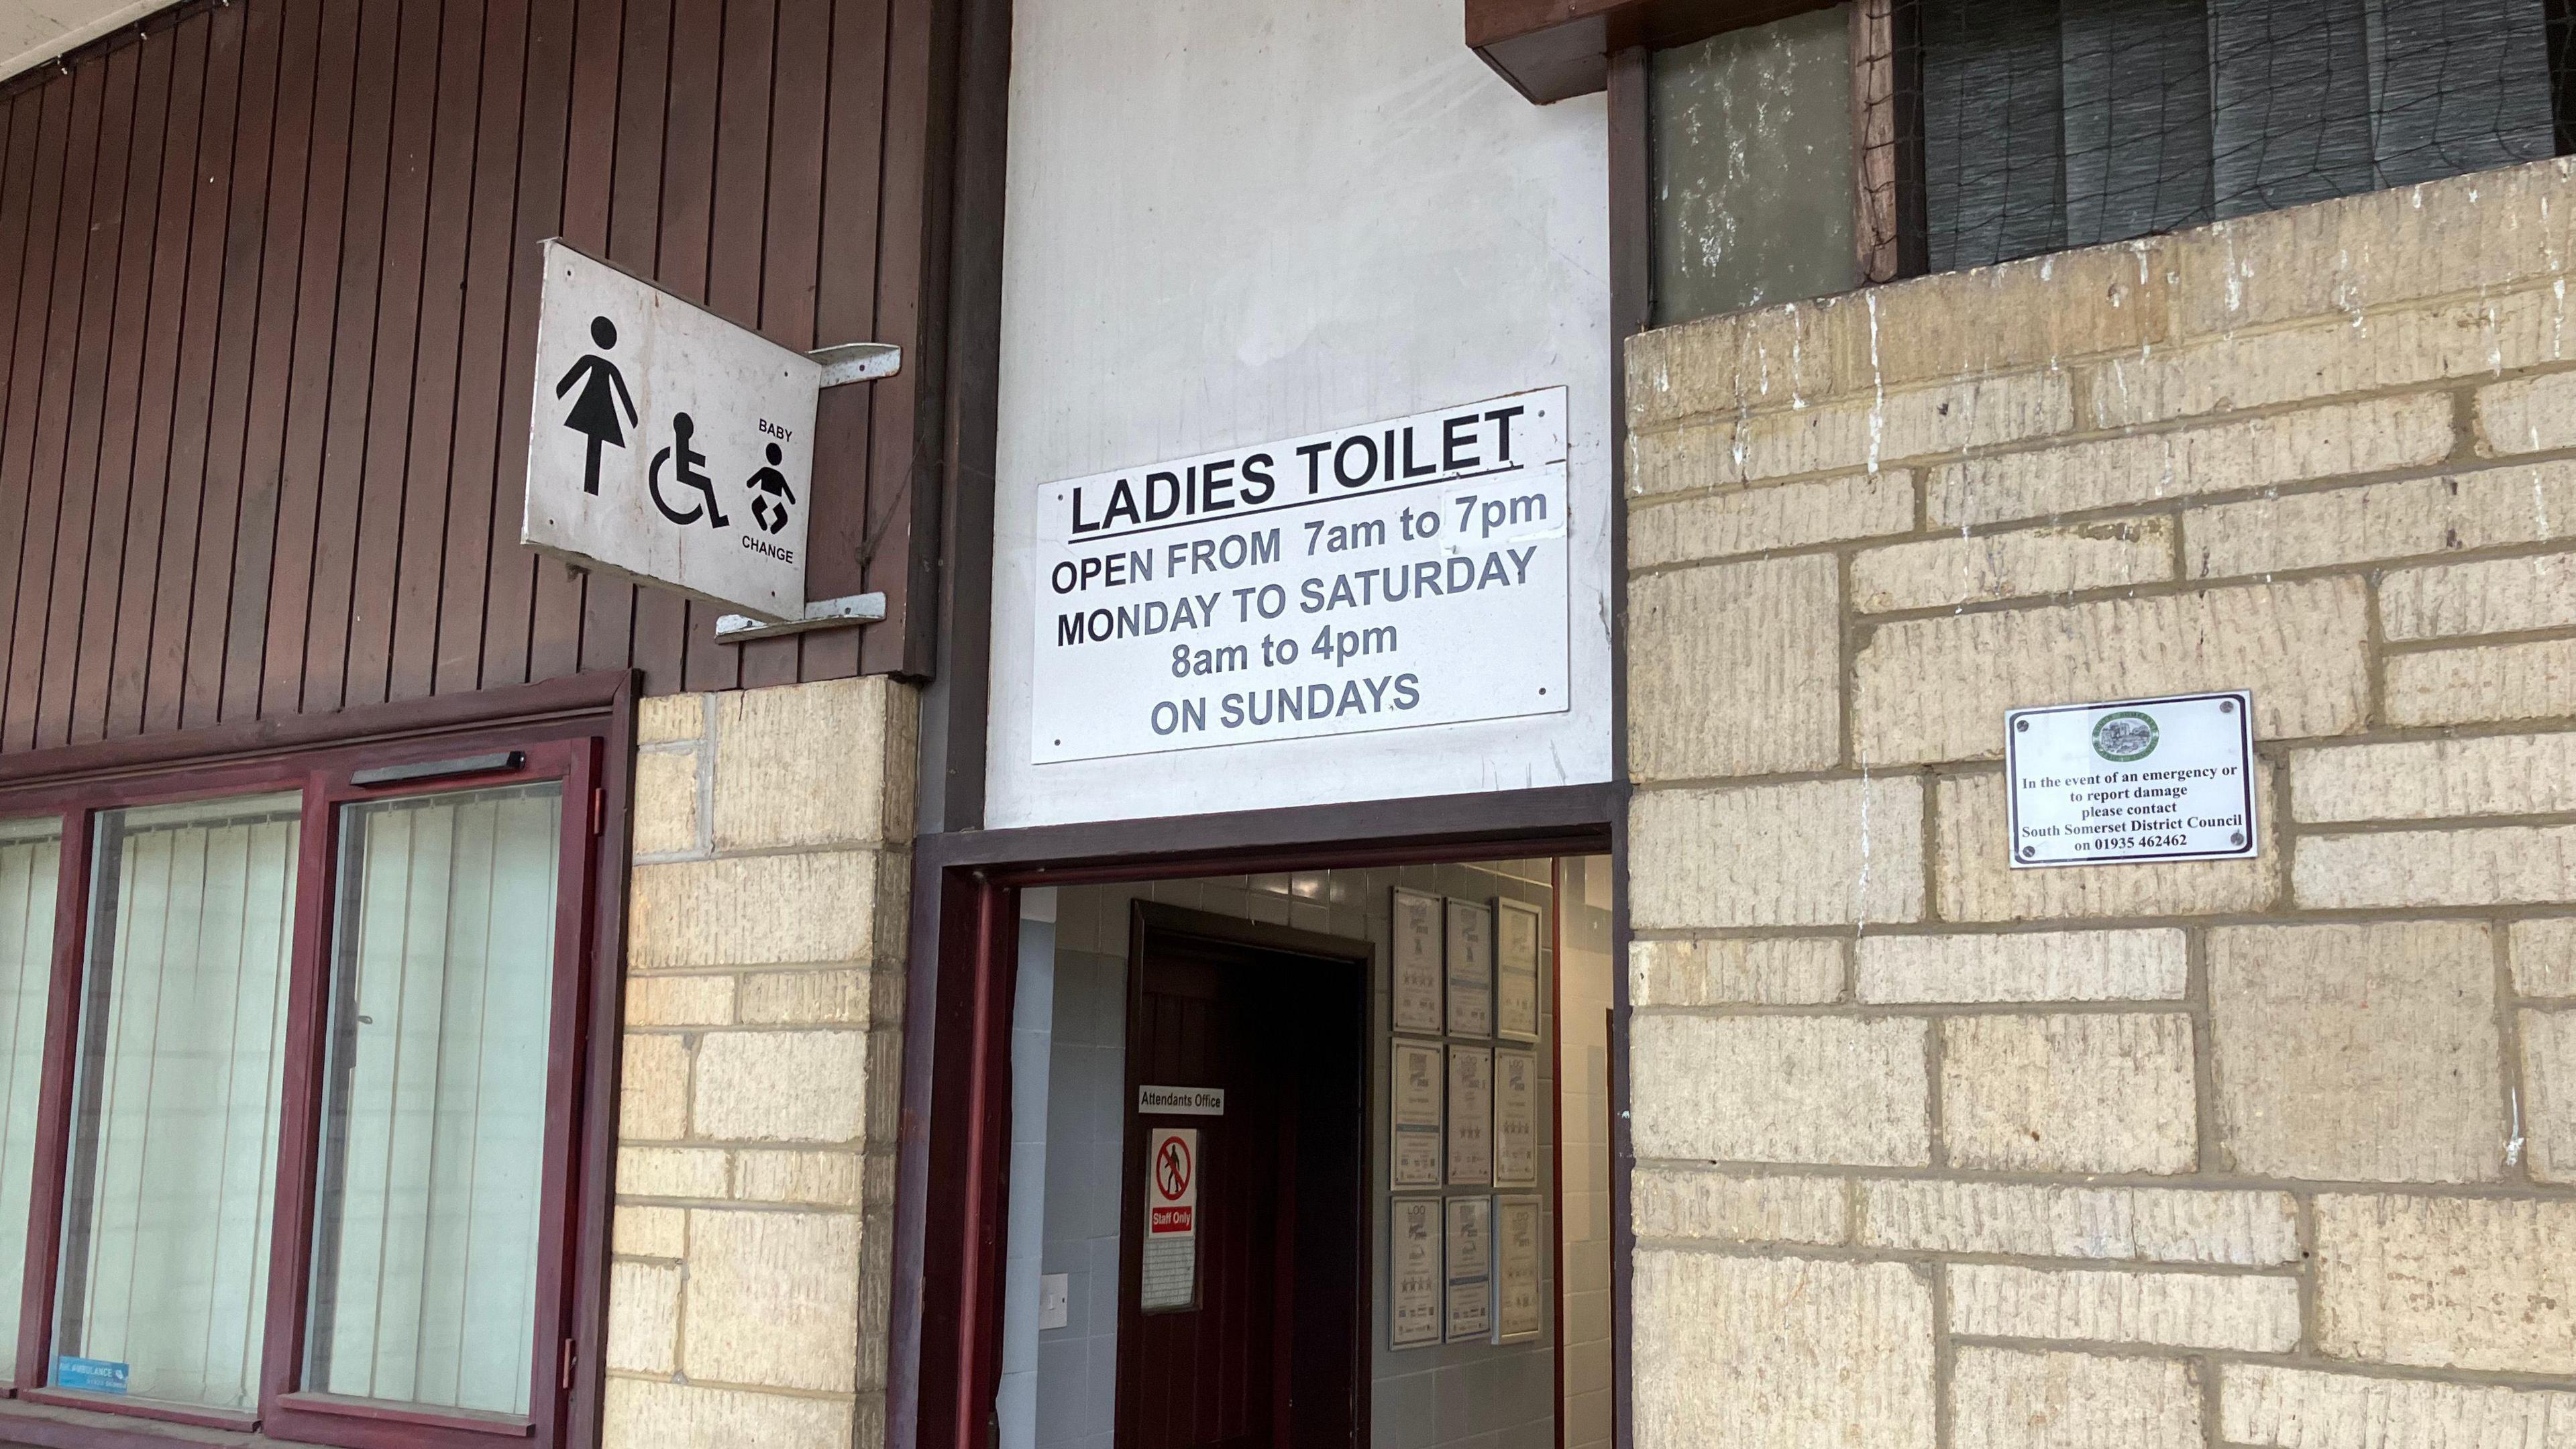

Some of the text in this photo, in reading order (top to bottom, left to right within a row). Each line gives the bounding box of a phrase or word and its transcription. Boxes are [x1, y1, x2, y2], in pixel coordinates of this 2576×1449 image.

[759, 419, 792, 442] BABY
[1071, 406, 1524, 534] LADIES TOILET
[742, 535, 794, 564] CHANGE
[1052, 492, 1547, 594] OPEN FROM 7am to 7pm
[1057, 546, 1538, 646] MONDAY TO SATURDAY
[1171, 623, 1398, 678] 8am to 4pm
[1150, 674, 1420, 735] ON SUNDAYS
[2023, 765, 2238, 789] In the event of an emergency or
[2070, 786, 2188, 803] to report damage
[2082, 802, 2176, 820] please contact
[2023, 815, 2242, 837] South Somerset District Council
[2074, 835, 2187, 851] on 01935 462462
[1141, 1092, 1220, 1108] Attendants Office
[1153, 1212, 1191, 1226] Staff Only
[1407, 1205, 1426, 1216] LOO
